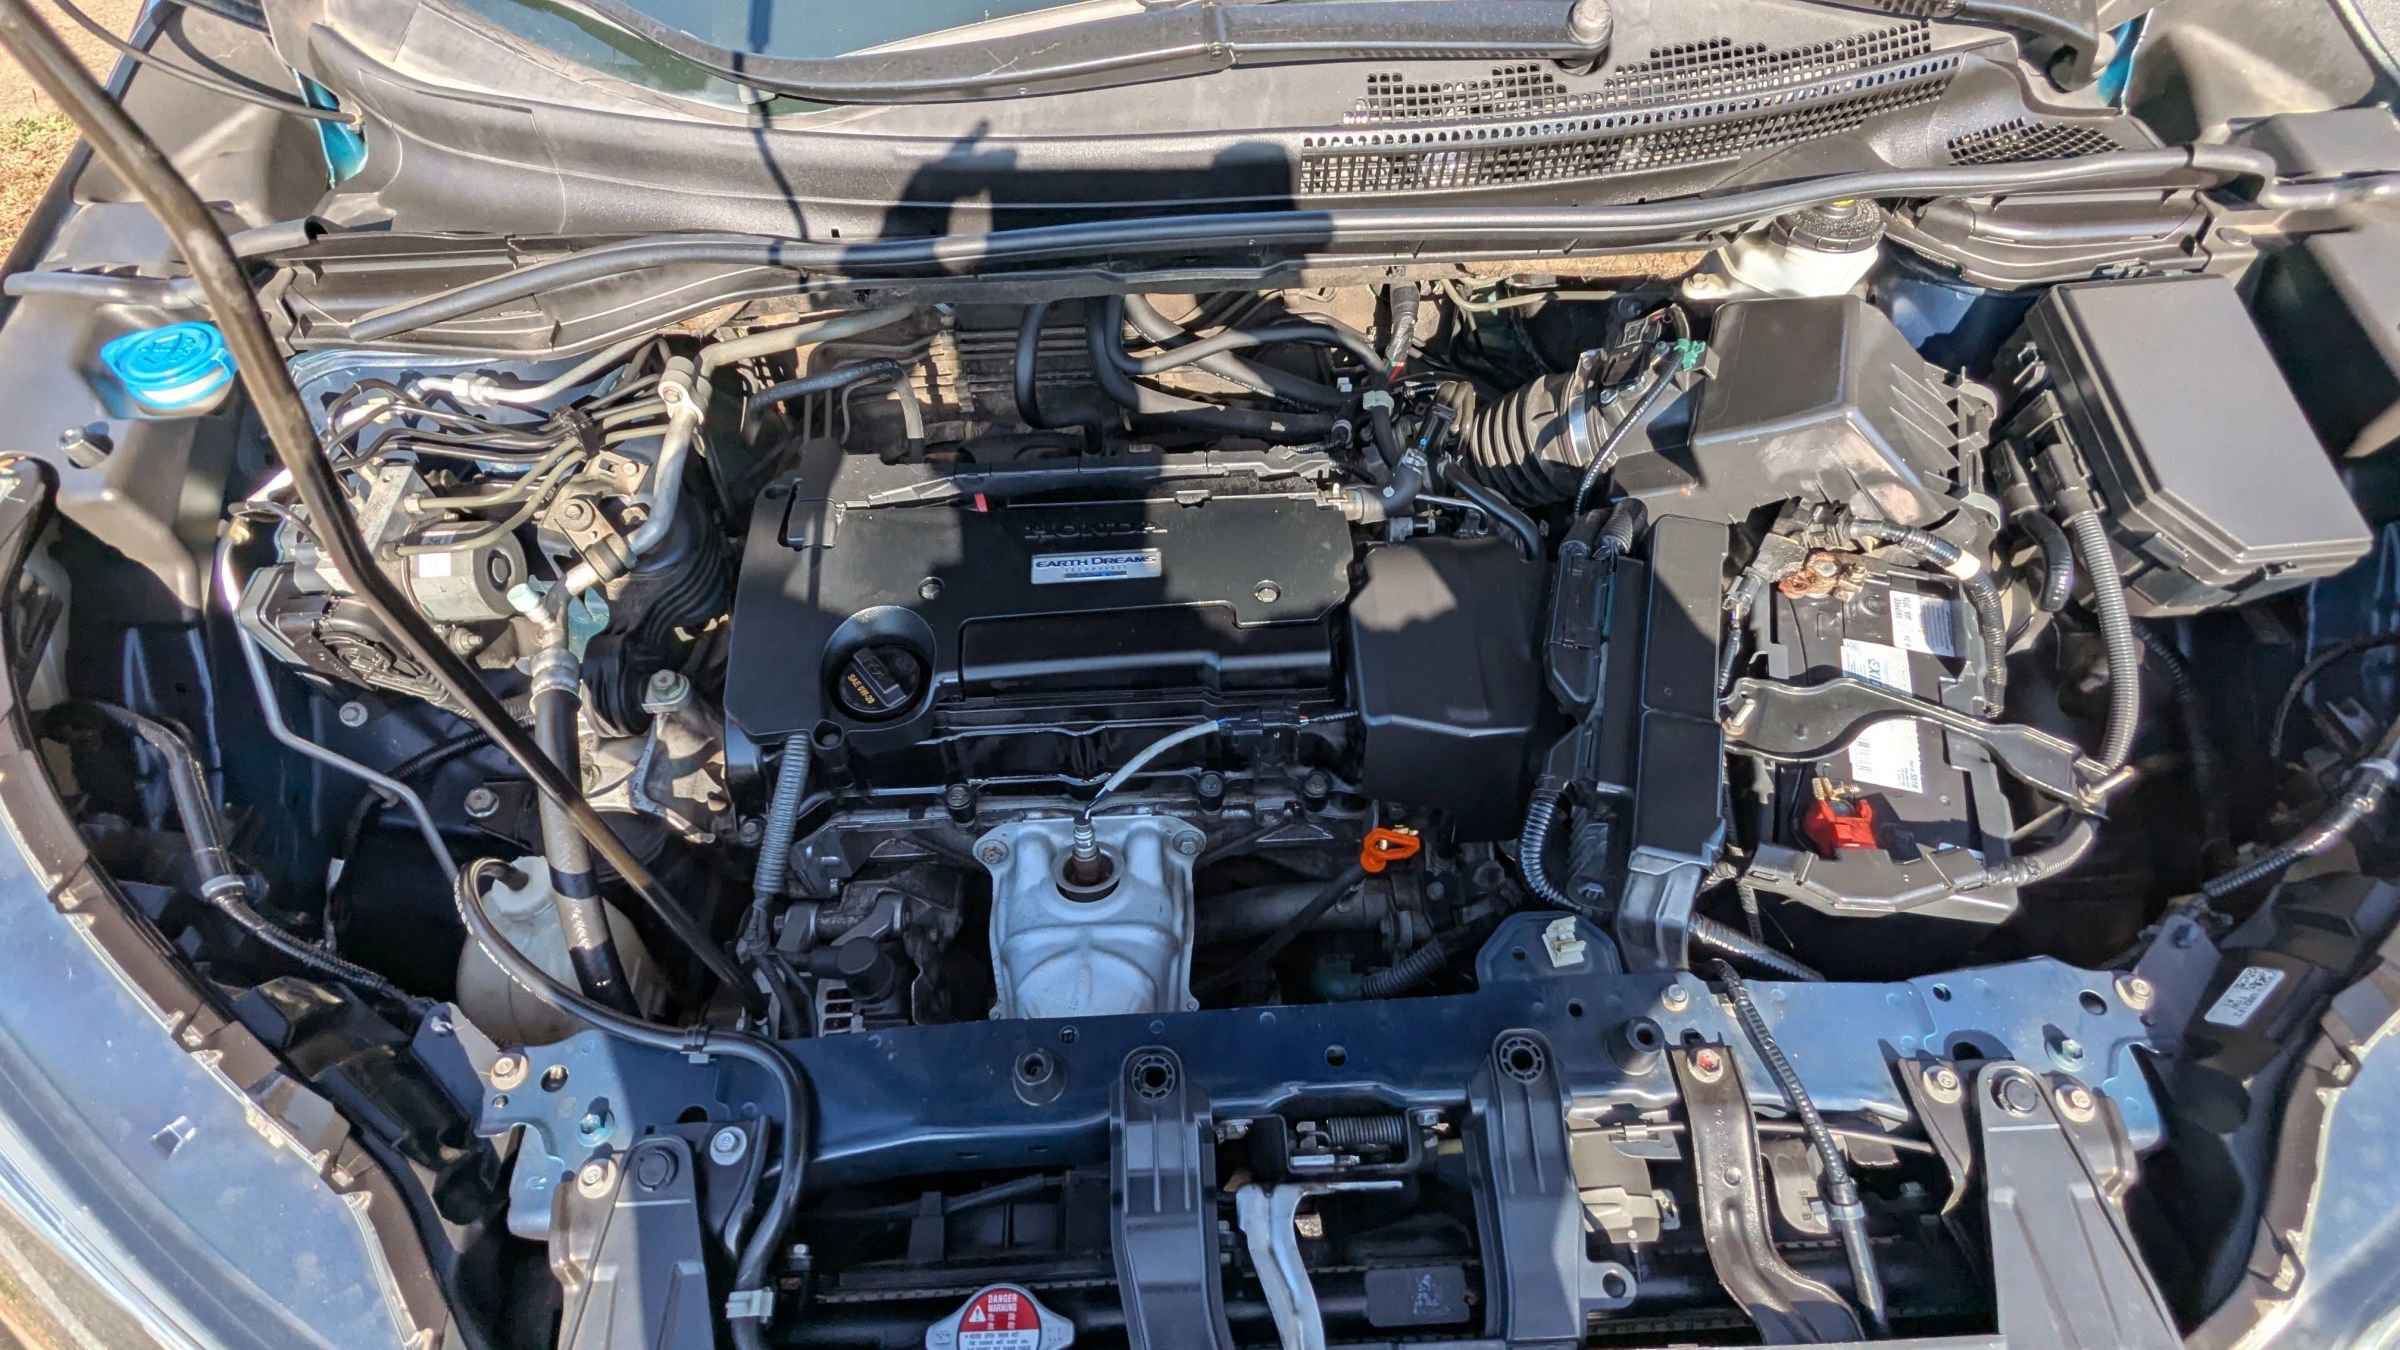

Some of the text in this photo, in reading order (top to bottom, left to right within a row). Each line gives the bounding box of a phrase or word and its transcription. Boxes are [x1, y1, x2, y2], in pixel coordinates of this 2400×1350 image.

[1036, 556, 1156, 568] EARTH DREAMS
[847, 674, 875, 704] SAE 0W-20
[988, 1294, 1017, 1304] DANGER
